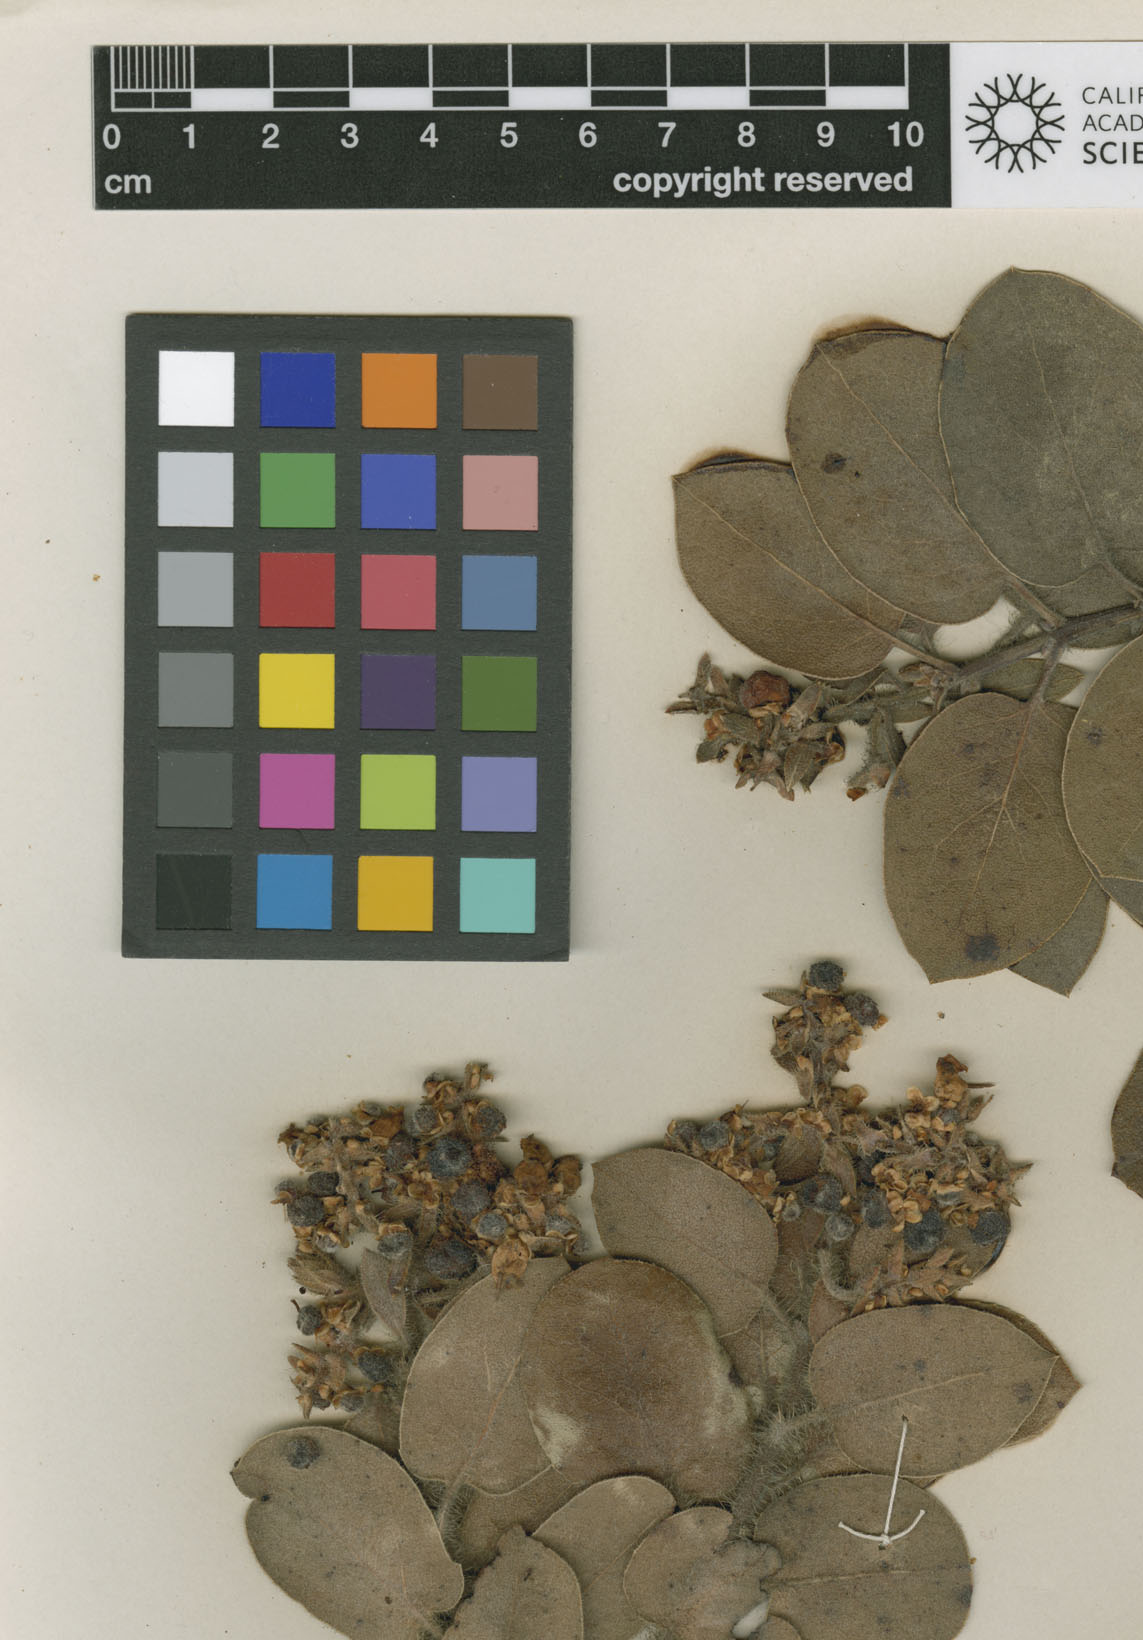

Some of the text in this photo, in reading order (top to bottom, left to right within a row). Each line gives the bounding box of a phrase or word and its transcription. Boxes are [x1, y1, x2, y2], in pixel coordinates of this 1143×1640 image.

[102, 121, 924, 149] 0 1 2 3 4 5 6 7 8 9 10
[104, 171, 152, 194] cm
[613, 166, 913, 198] copyright reserved
